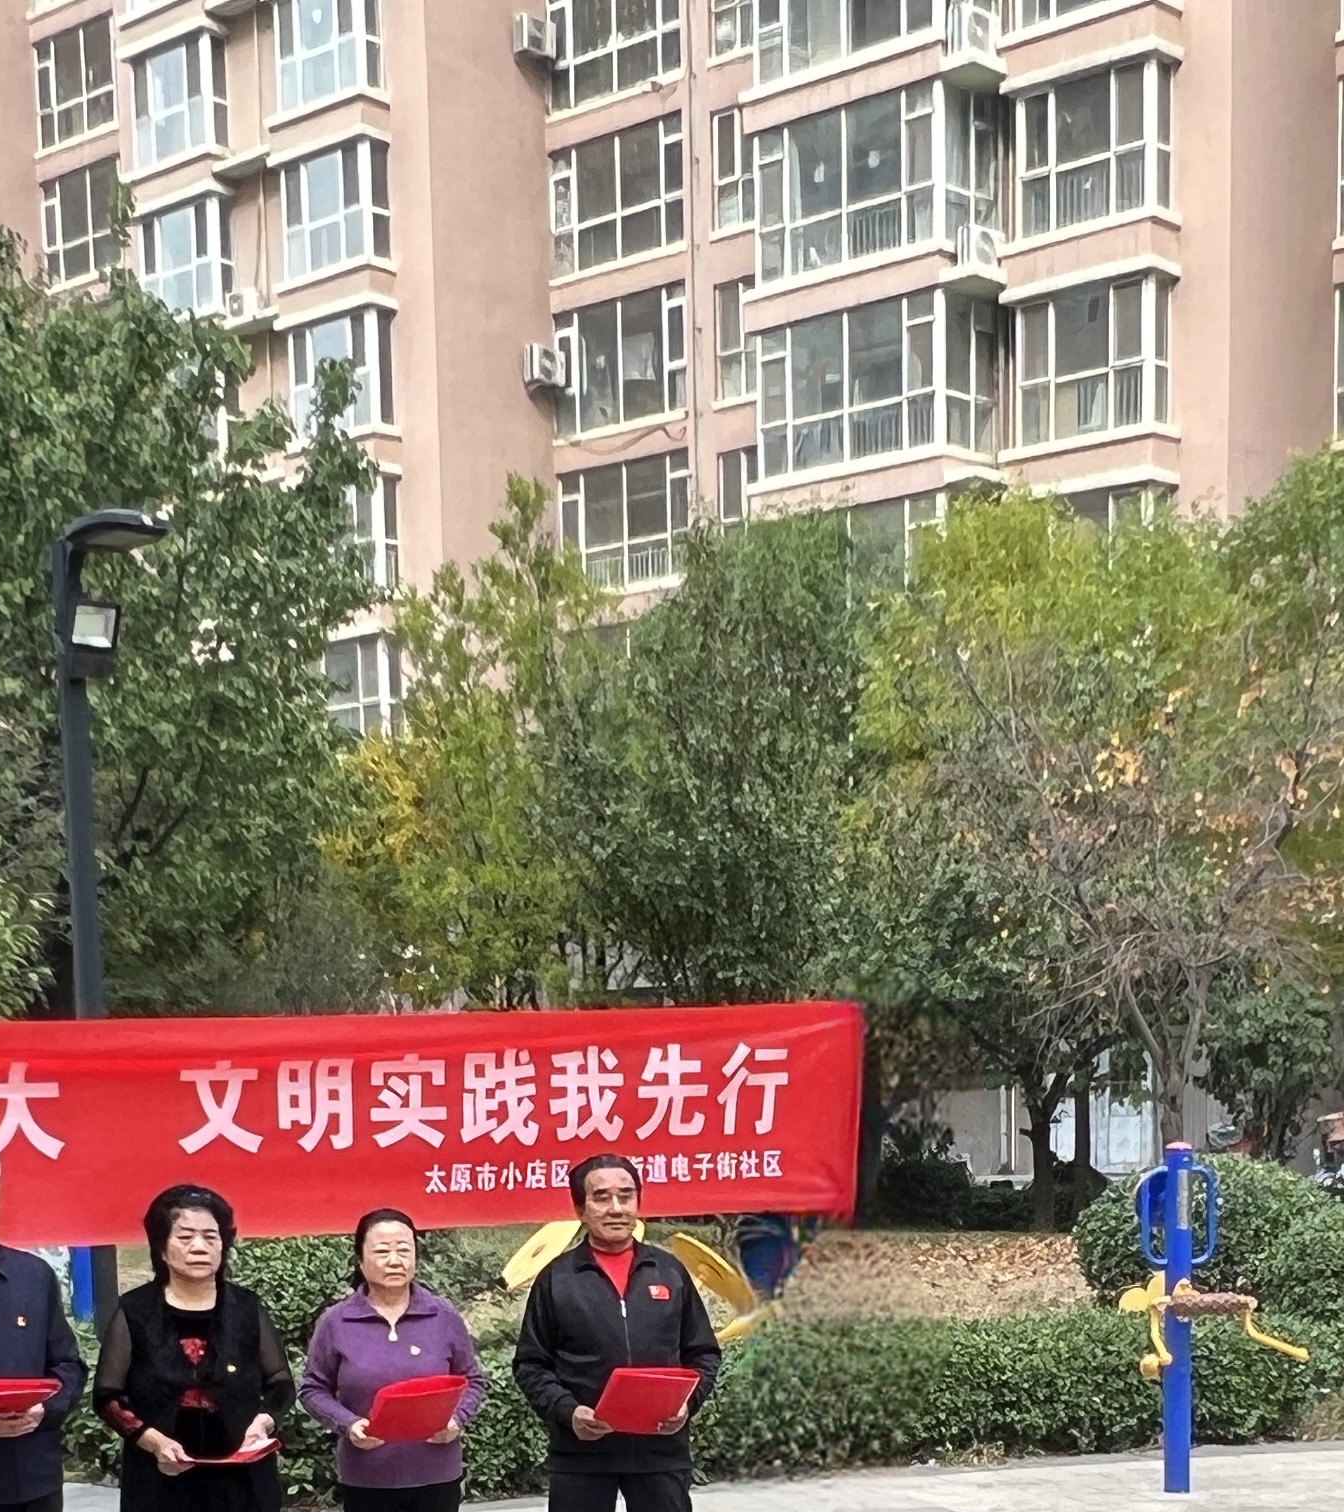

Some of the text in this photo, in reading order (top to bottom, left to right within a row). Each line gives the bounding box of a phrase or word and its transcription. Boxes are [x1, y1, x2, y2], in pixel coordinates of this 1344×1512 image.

[178, 1042, 789, 1154] 文明实践我先行
